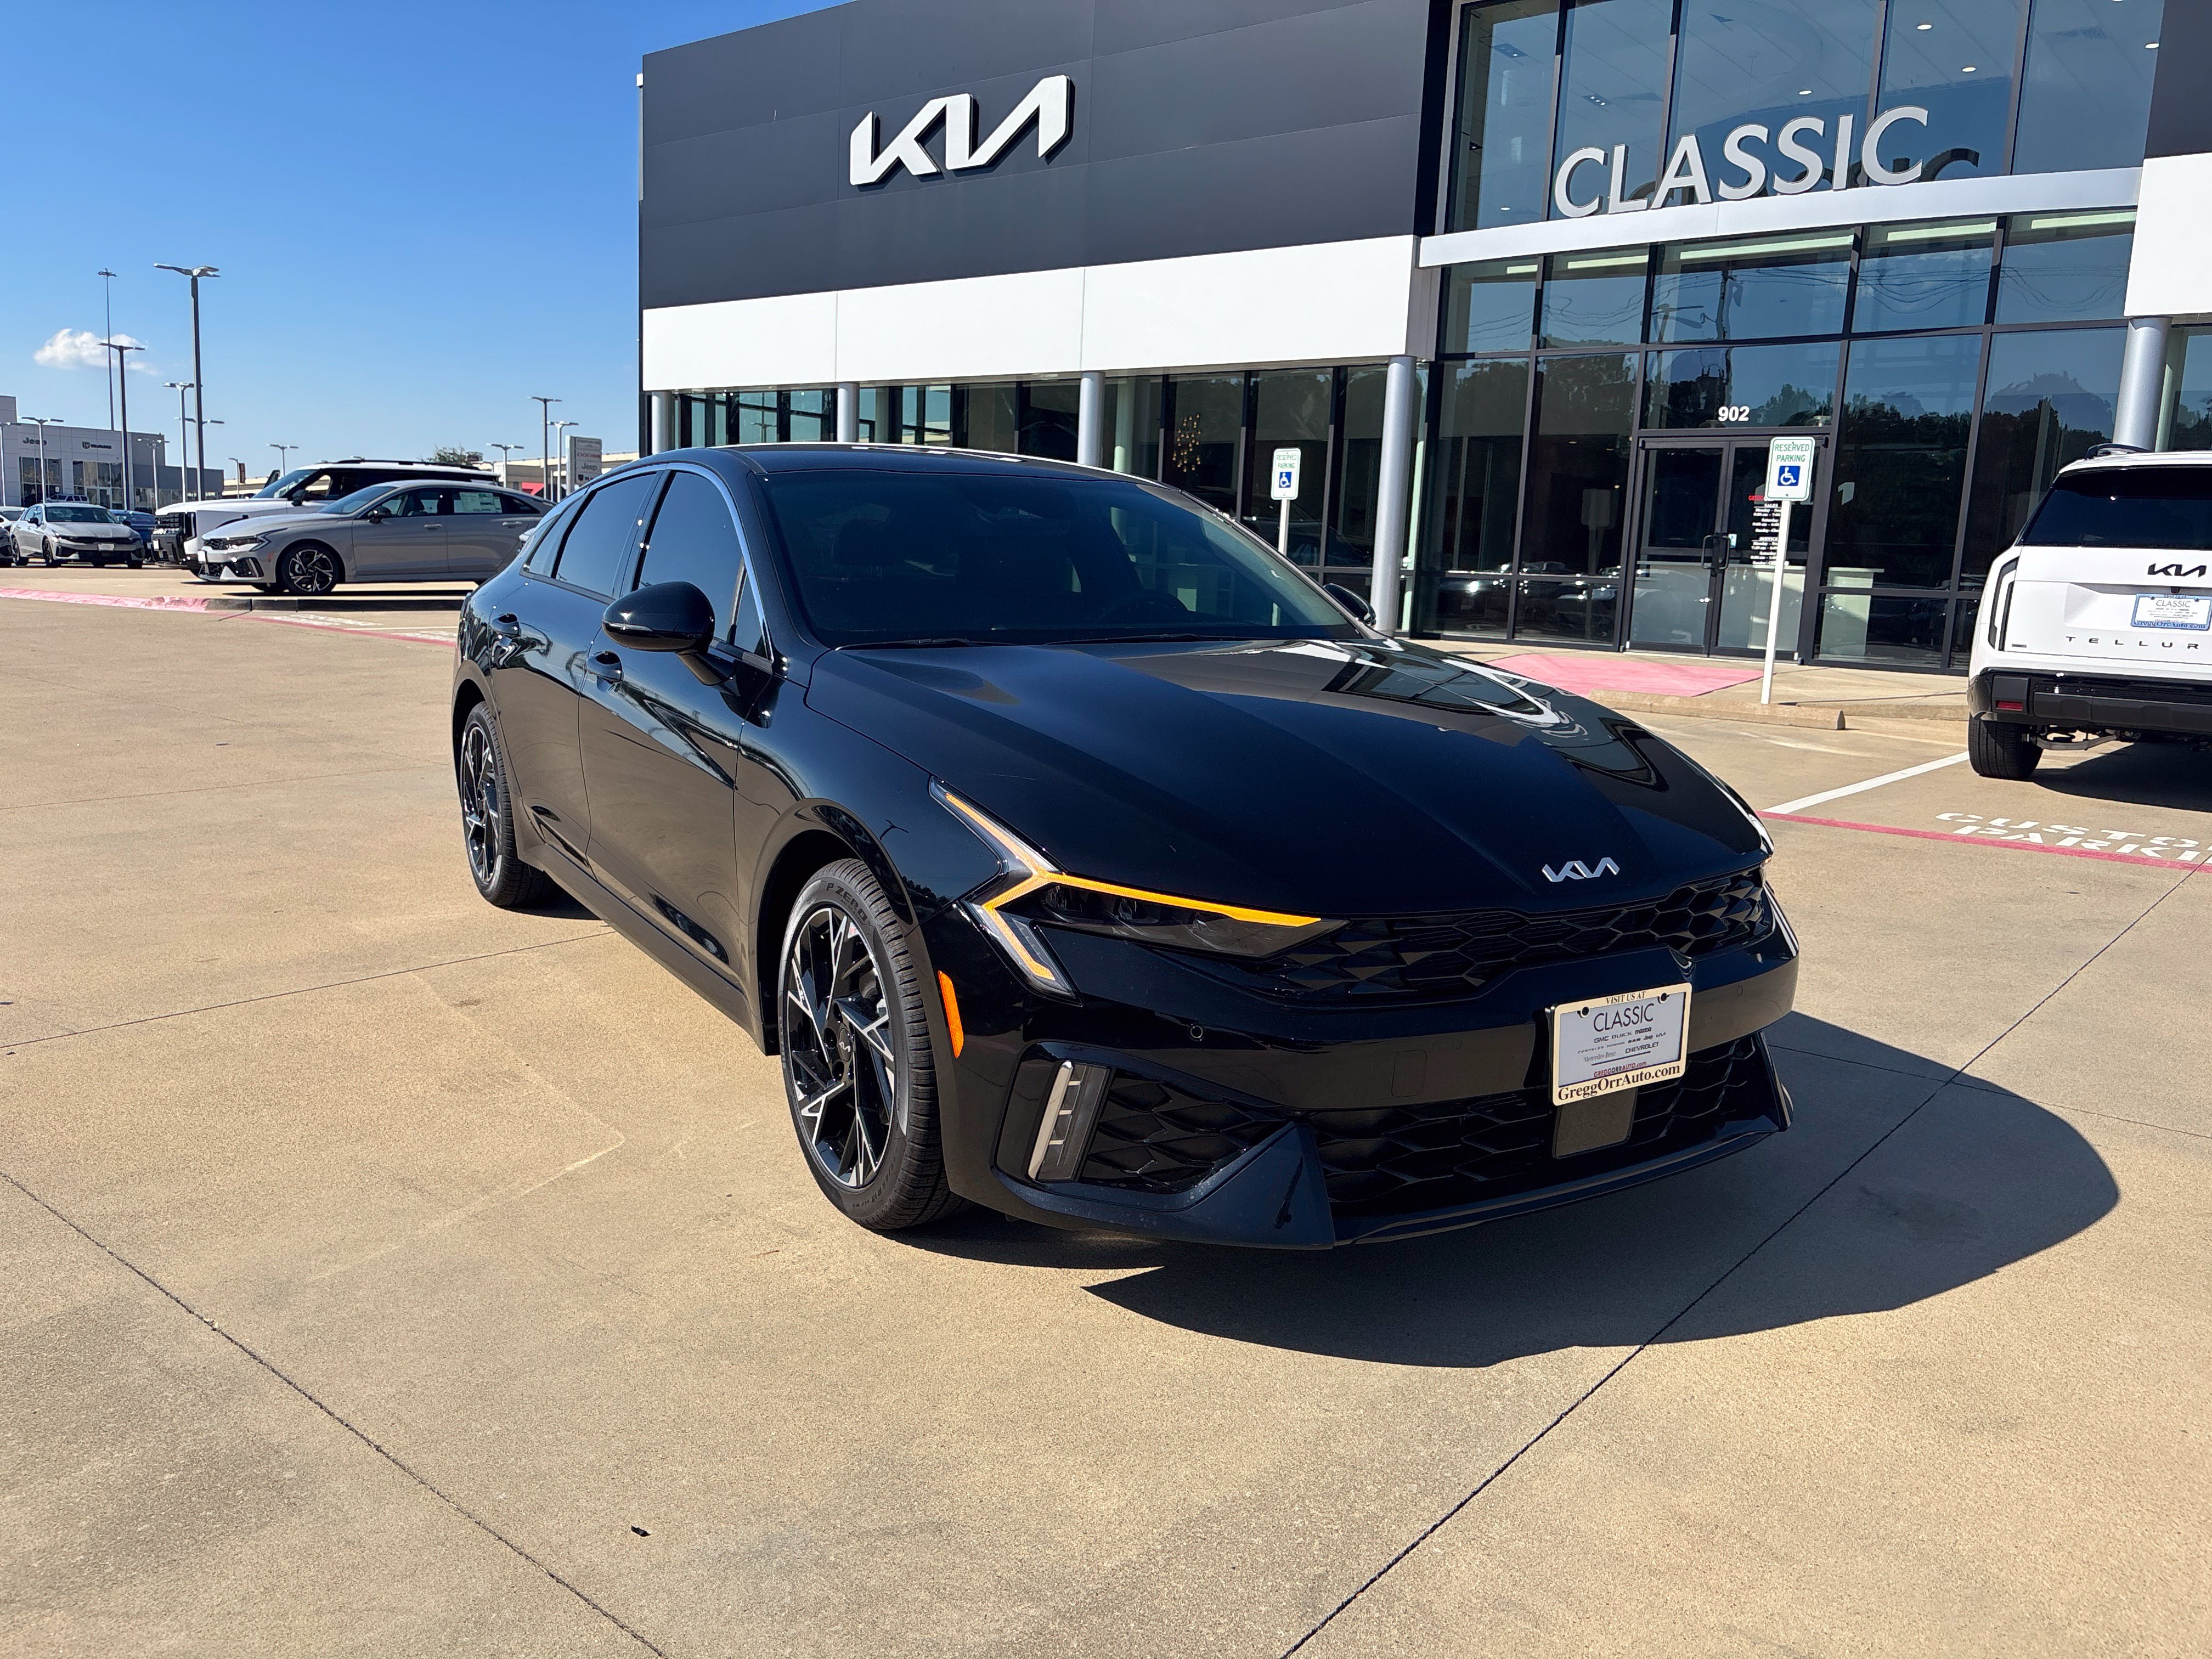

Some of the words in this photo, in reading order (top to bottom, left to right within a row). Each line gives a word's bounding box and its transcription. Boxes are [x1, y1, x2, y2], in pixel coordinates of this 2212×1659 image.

[850, 75, 1070, 185] KIA
[1554, 105, 1929, 218] CLASSIC
[1718, 406, 1750, 422] 902
[582, 462, 597, 471] Jeep
[2147, 562, 2207, 578] KIA
[2156, 600, 2191, 608] CLASSIC
[2065, 636, 2199, 650] TELLUR
[1936, 812, 2212, 851] CUSTO
[1953, 825, 2212, 865] PARKI
[1542, 857, 1620, 882] KIA
[835, 885, 868, 922] ZERO
[1606, 995, 1626, 1005] VISIT
[1626, 993, 1635, 1001] US
[1637, 991, 1646, 1000] AT
[1593, 1003, 1655, 1032] CLASSIC
[1584, 1051, 1616, 1062] Mercedes-Benz
[1625, 1042, 1659, 1054] CHEVROLET
[1594, 1062, 1647, 1077] GREGGORRAUTO.com
[1558, 1065, 1680, 1101] GreggOrrAuto.com
